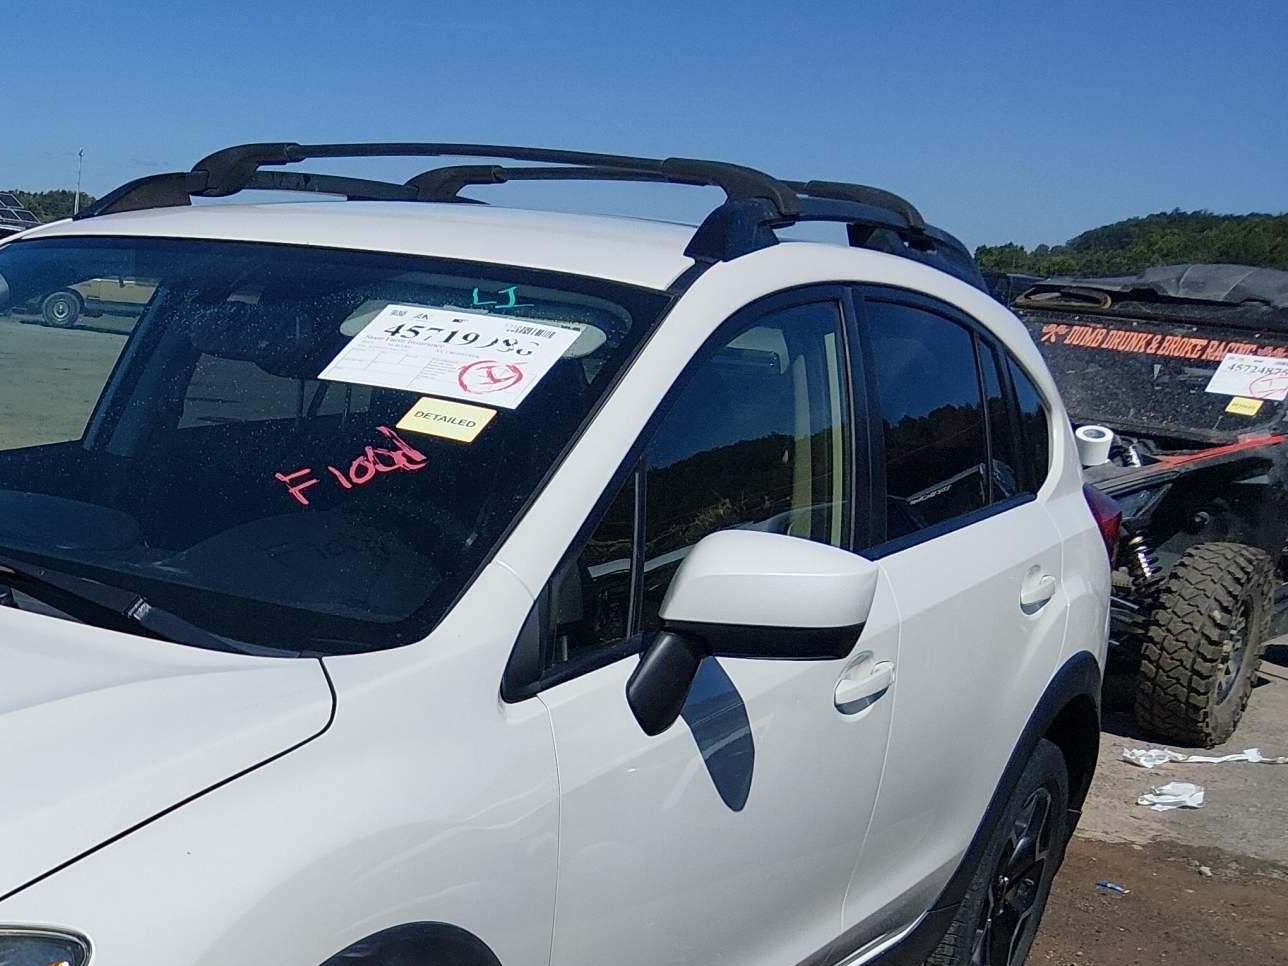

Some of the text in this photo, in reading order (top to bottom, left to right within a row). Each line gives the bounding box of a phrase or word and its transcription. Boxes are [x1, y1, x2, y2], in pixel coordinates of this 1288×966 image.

[1063, 325, 1107, 348] DUMB
[1100, 329, 1154, 353] DRUNK
[1146, 334, 1163, 355] &
[1156, 335, 1209, 359] BROKE
[414, 410, 476, 429] DETAILED
